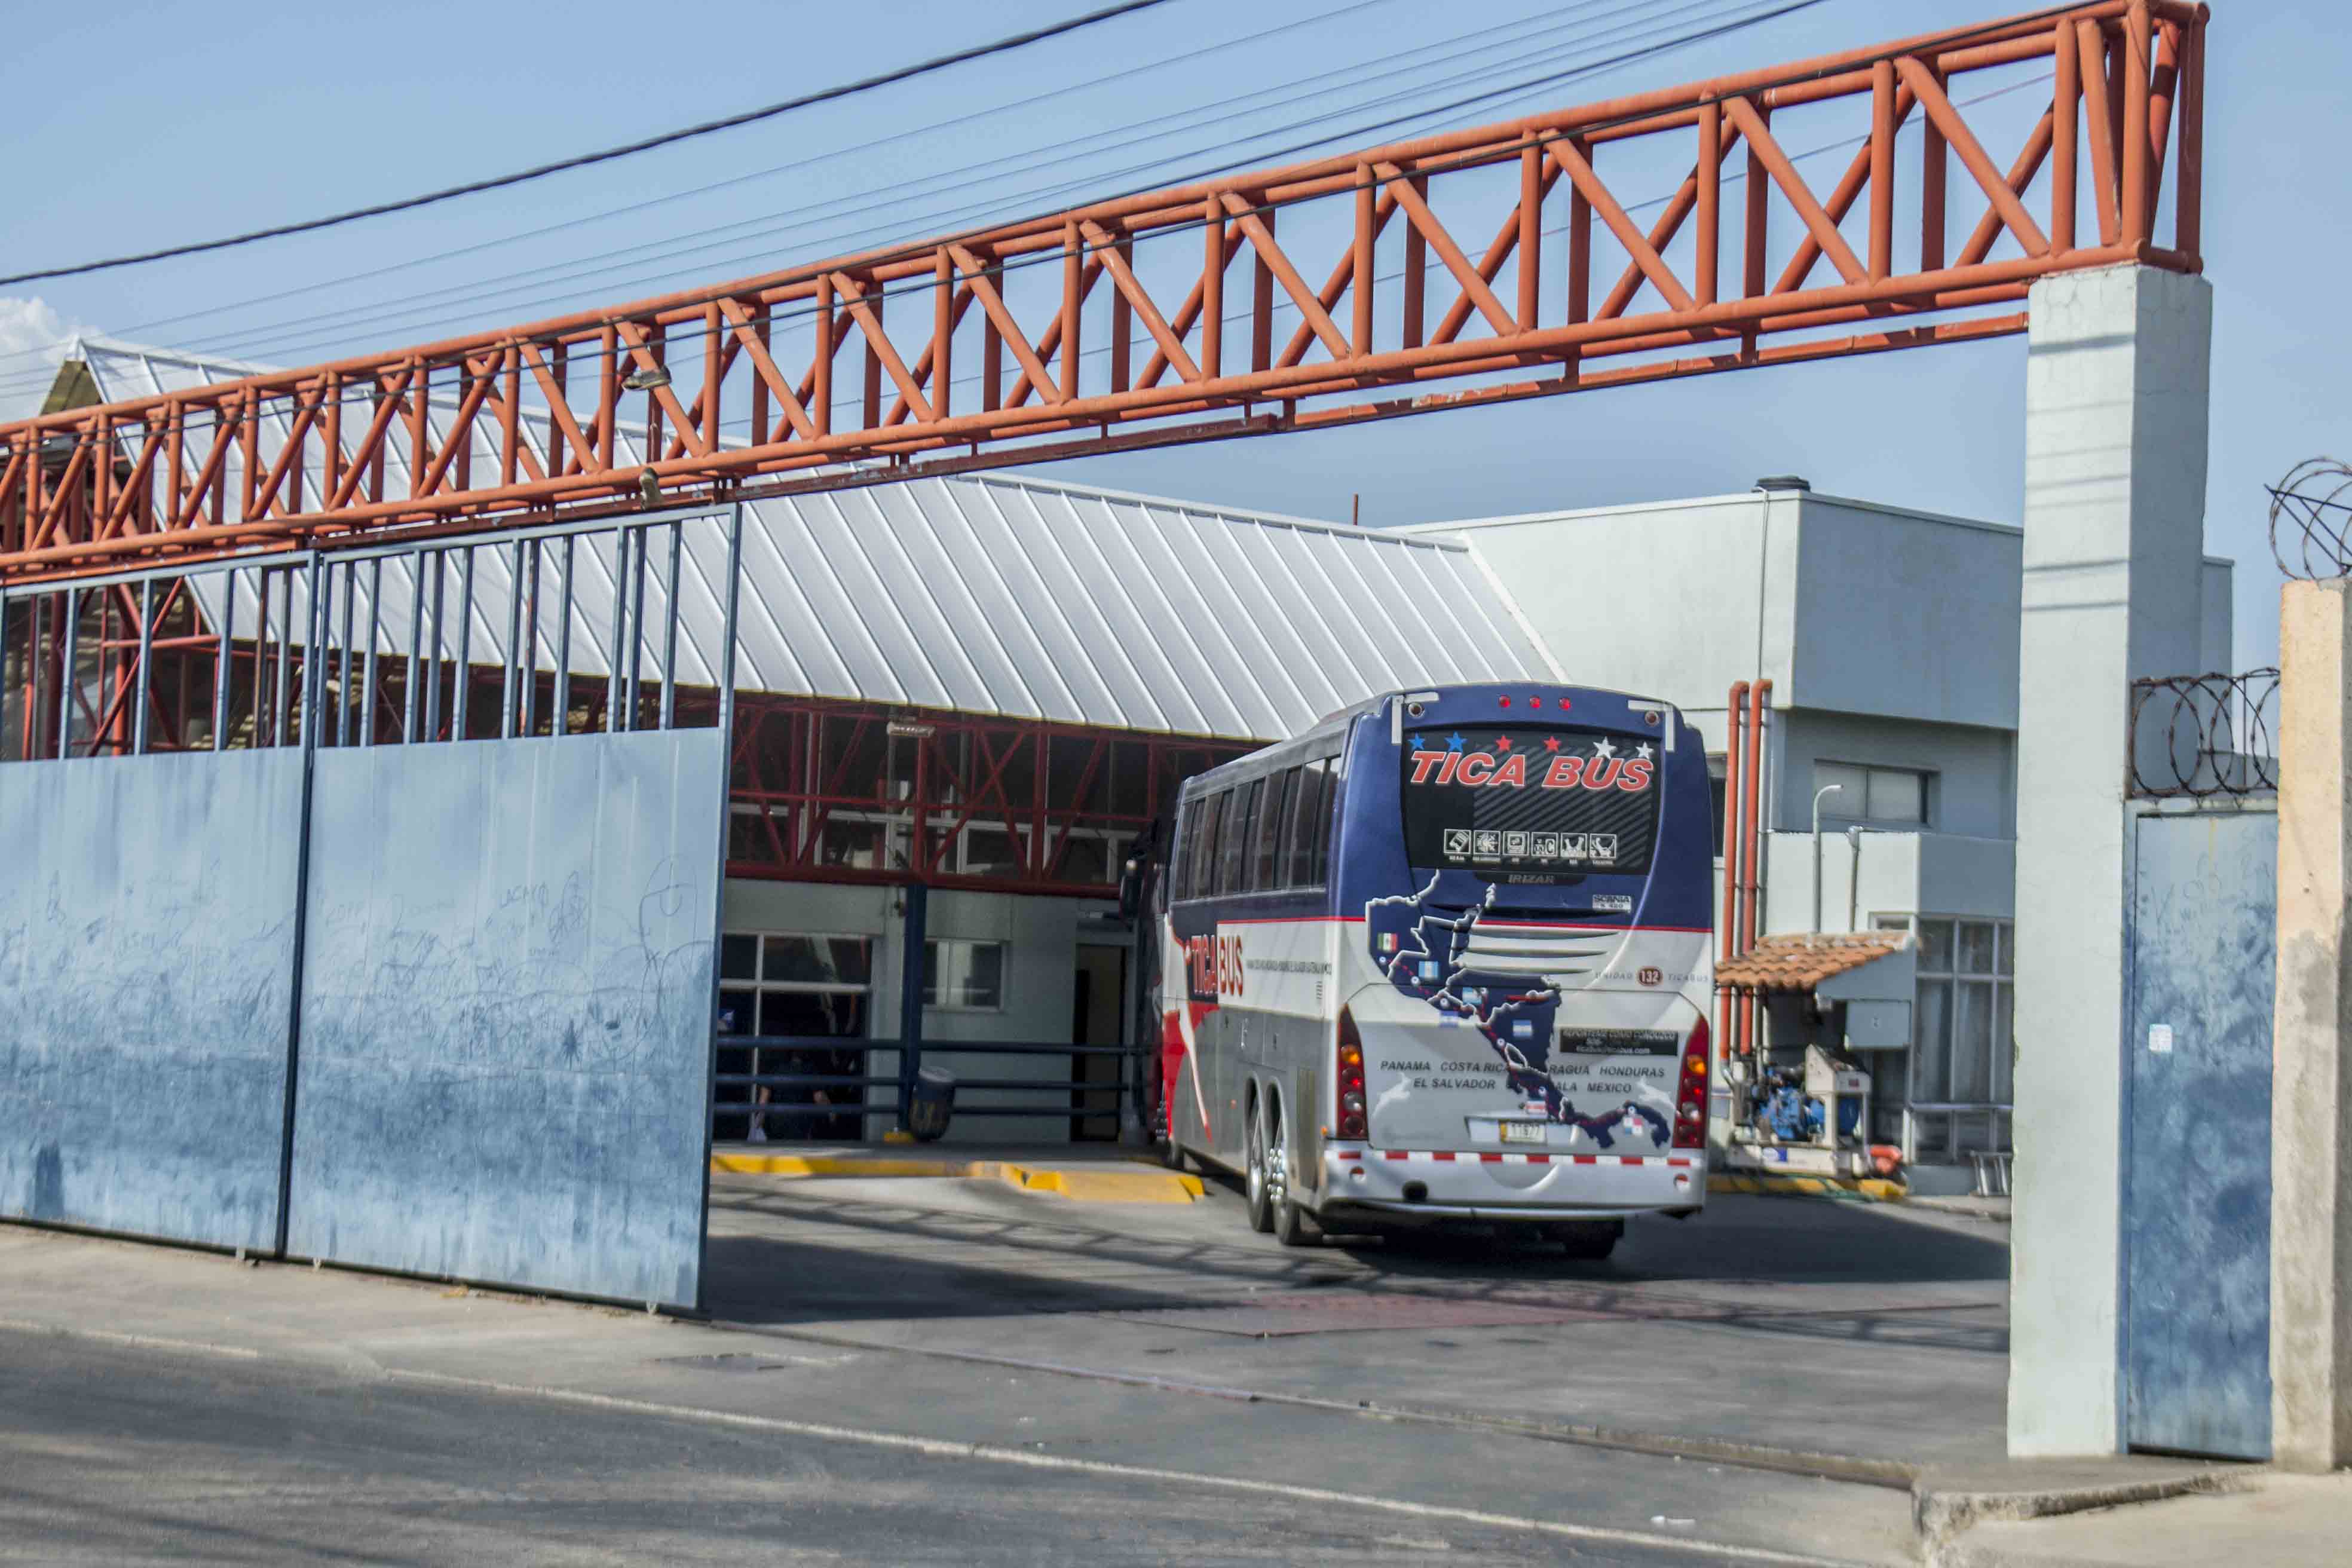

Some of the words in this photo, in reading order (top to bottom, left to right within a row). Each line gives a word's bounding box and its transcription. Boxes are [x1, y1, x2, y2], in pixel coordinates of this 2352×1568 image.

[1410, 751, 1526, 786] TICA
[1542, 755, 1655, 791] BUS
[1508, 874, 1554, 884] IRIZAR
[1593, 894, 1630, 903] SCANIA
[1191, 934, 1218, 995] TICA
[1218, 935, 1244, 997] BUS
[1640, 970, 1659, 983] 132
[1380, 1061, 1431, 1071] PANAMA
[1440, 1061, 1480, 1072] COSTA
[1599, 1065, 1665, 1077] HONDURAS
[1413, 1077, 1428, 1088] EL
[1432, 1078, 1496, 1089] SALVADOR
[1587, 1082, 1632, 1094] MEXICO
